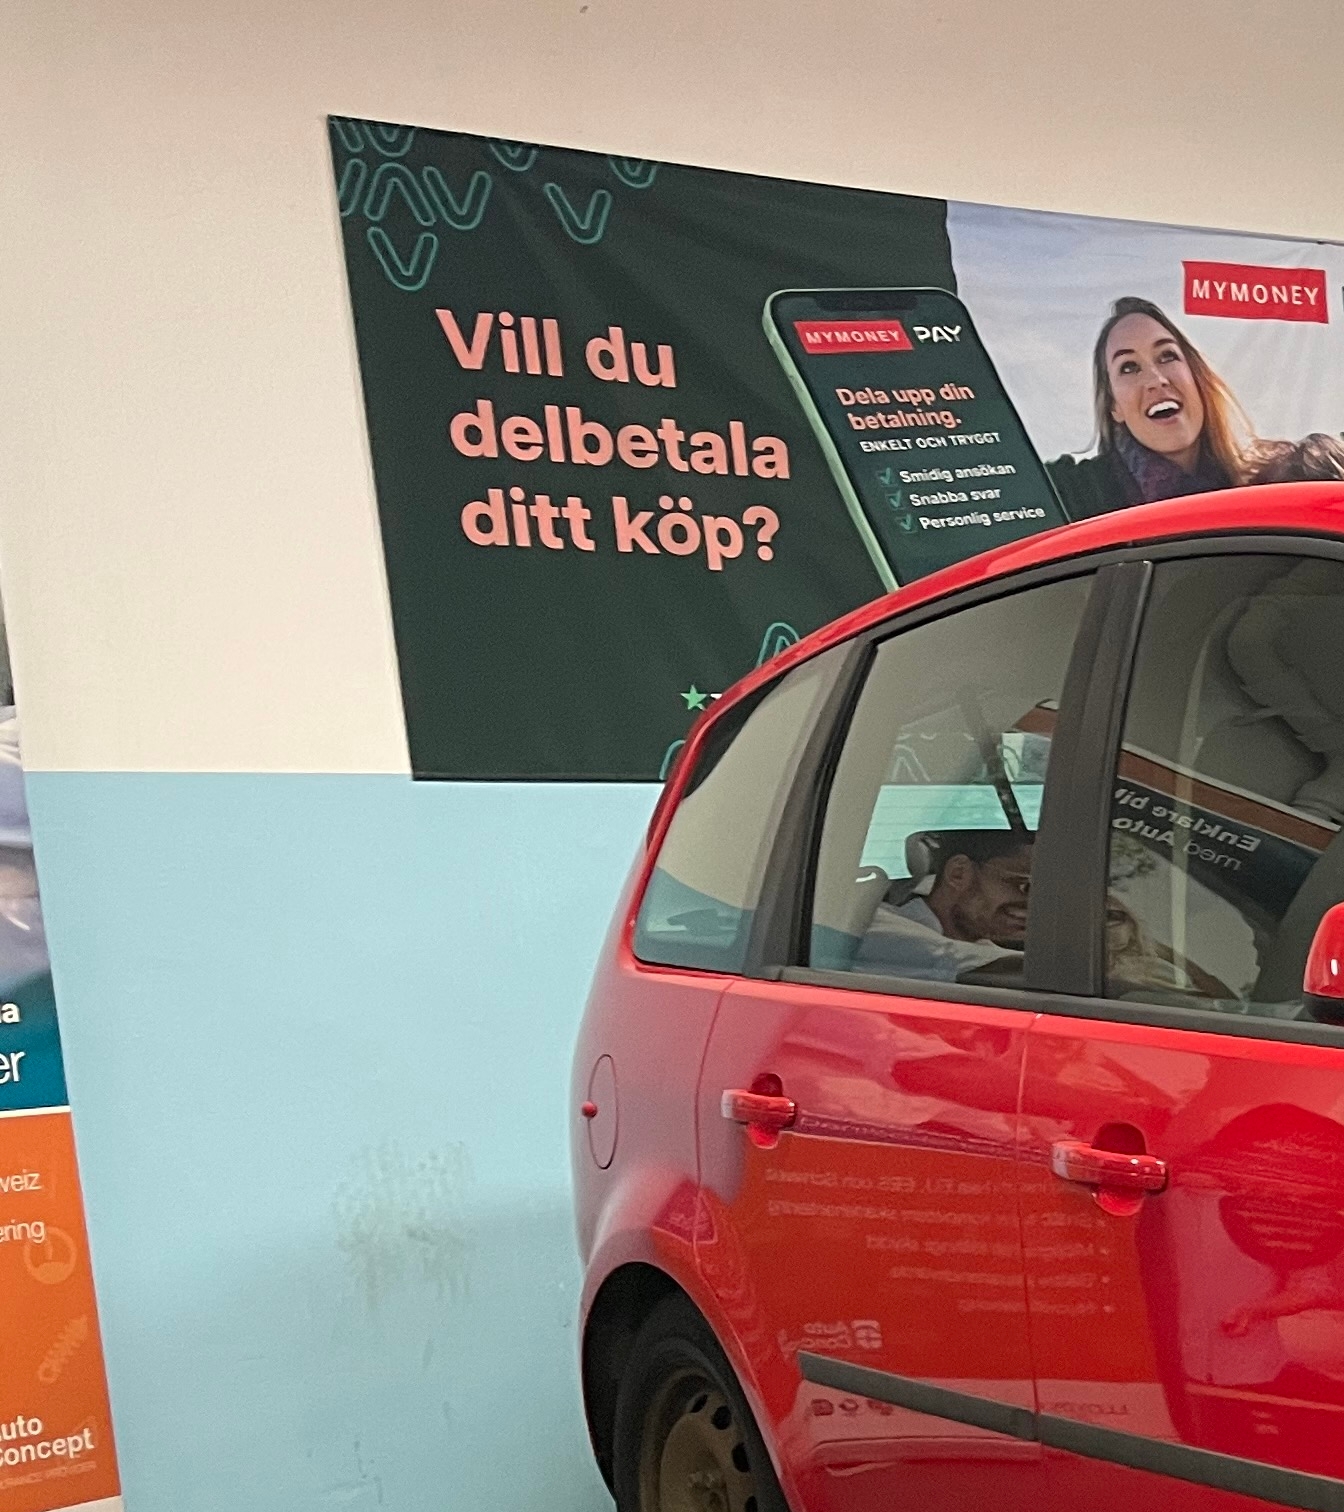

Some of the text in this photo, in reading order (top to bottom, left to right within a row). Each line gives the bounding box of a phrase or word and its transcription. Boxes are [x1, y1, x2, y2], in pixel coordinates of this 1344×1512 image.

[1192, 279, 1319, 306] MYMONEY
[804, 325, 962, 345] MYMONEY PAY
[435, 309, 677, 388] Vill du
[835, 382, 975, 407] Dela upp din
[847, 408, 962, 431] betalning.
[450, 399, 790, 480] delbetala
[859, 432, 1001, 453] ENKELT OCH TRYGGT
[899, 463, 1016, 483] Smidig ansökan
[909, 488, 1002, 507] Snabba svar
[461, 486, 780, 571] ditt köp?
[918, 506, 1045, 530] Personlig service
[0, 1414, 43, 1441] uto
